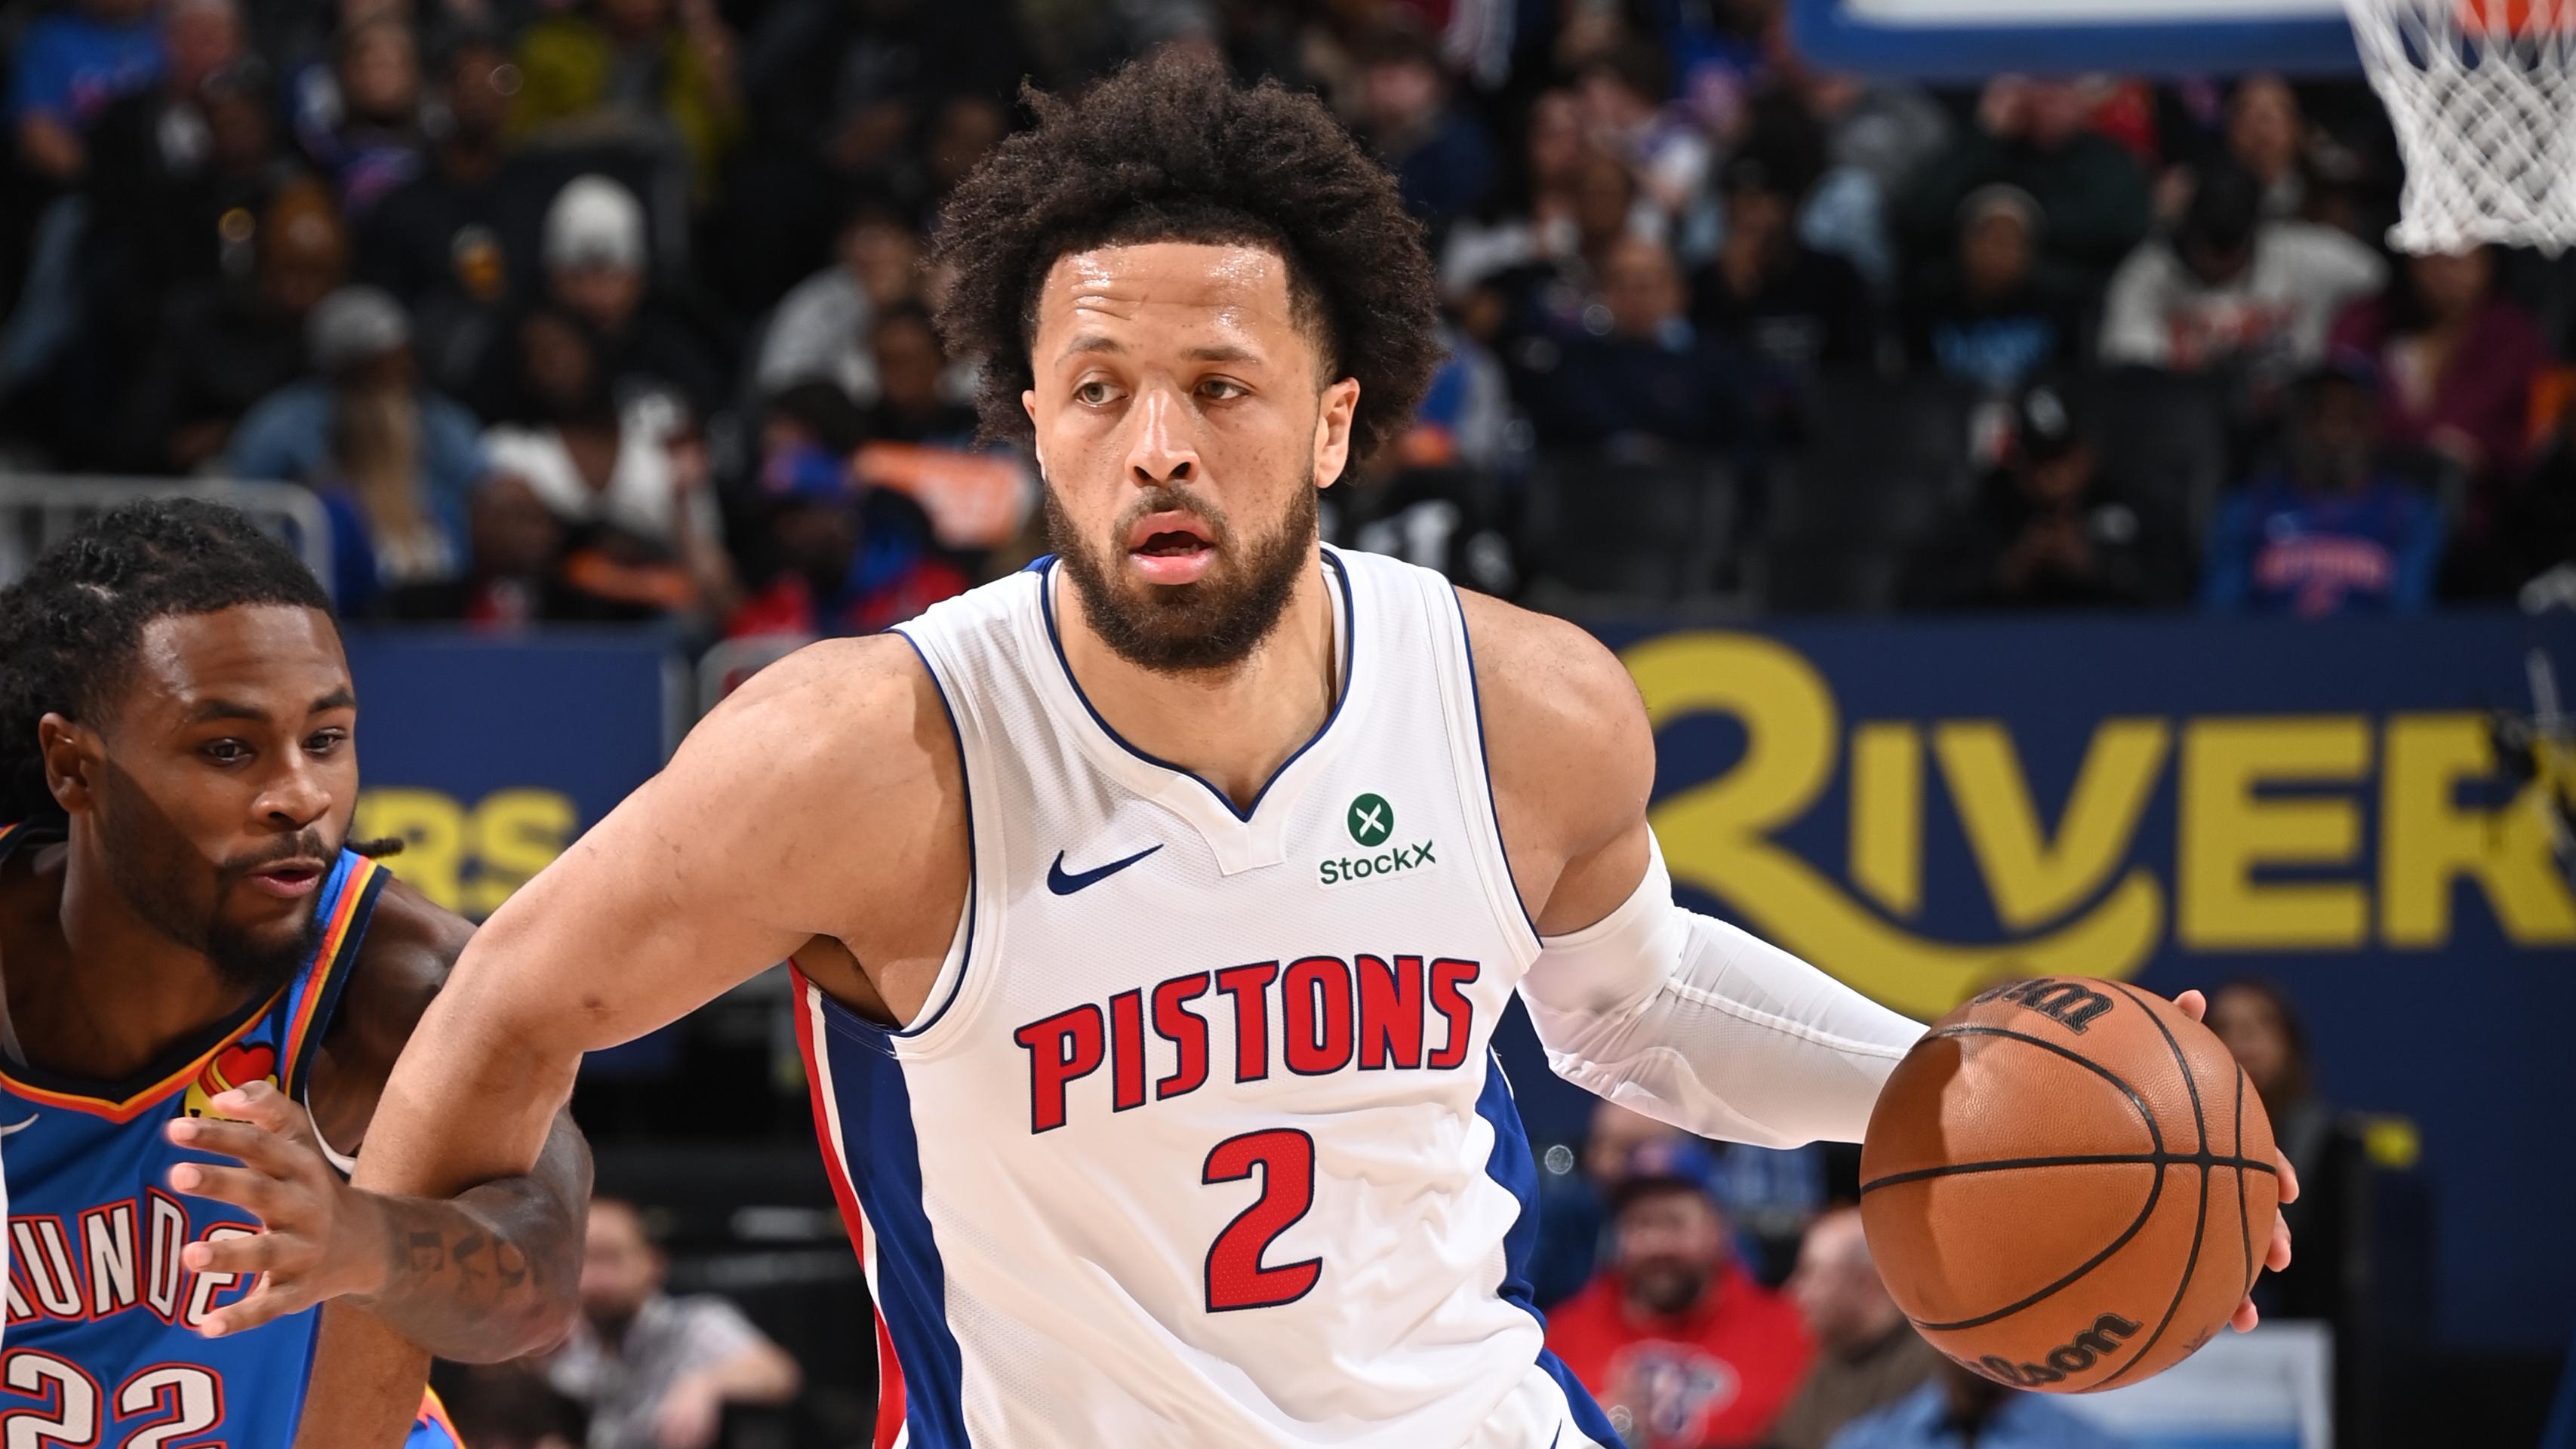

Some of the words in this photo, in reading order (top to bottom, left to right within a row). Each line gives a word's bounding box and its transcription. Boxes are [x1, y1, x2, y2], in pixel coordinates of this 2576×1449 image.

[1319, 838, 1436, 885] StockX
[1014, 954, 1481, 1135] PISTONS
[1202, 1127, 1323, 1314] 2
[0, 1347, 226, 1449] 22
